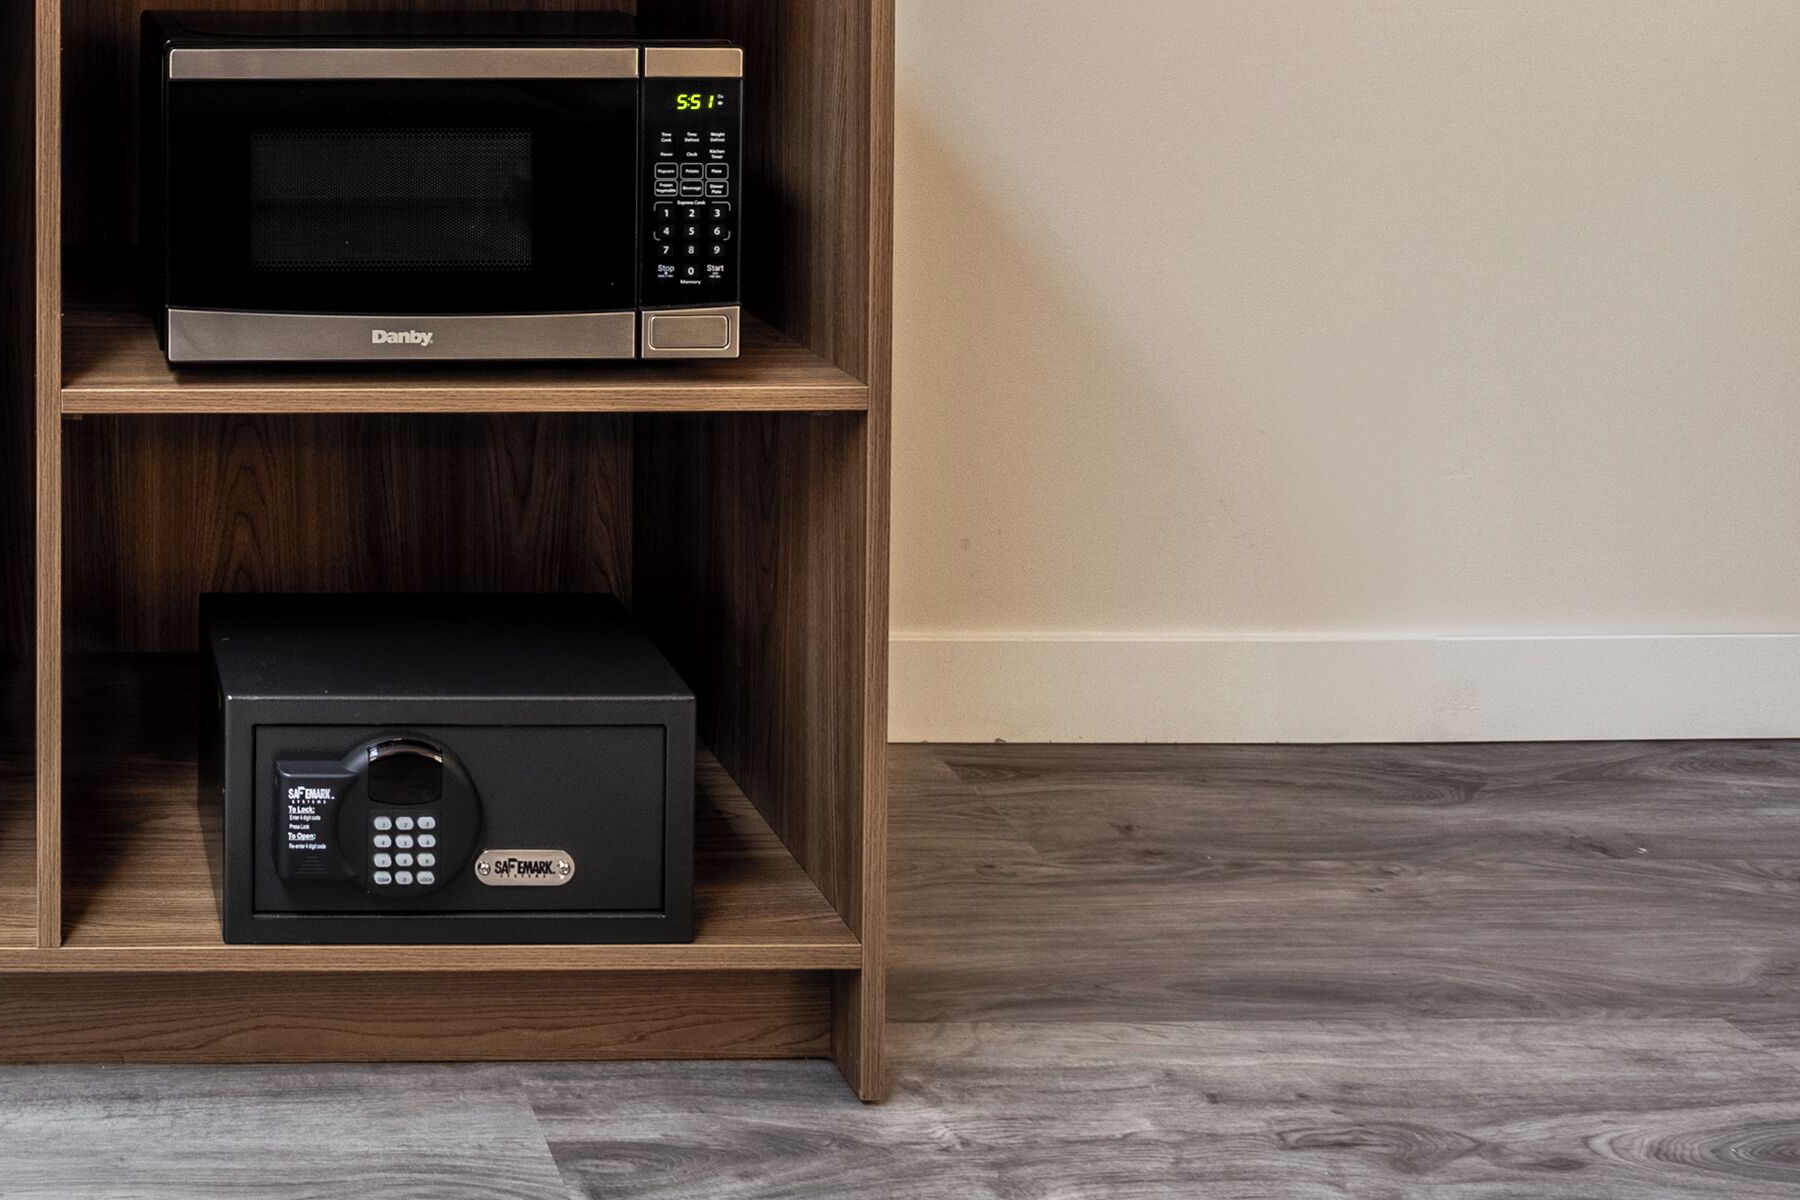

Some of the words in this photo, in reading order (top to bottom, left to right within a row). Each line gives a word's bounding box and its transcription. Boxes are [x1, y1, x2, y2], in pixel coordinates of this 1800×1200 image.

[677, 94, 714, 110] 5:51
[664, 209, 669, 218] 1
[688, 209, 695, 218] 2
[714, 209, 721, 218] 3
[663, 227, 670, 236] 4
[688, 227, 695, 236] 5
[713, 227, 721, 236] 6
[663, 246, 670, 255] 7
[688, 246, 695, 255] 8
[713, 246, 721, 255] 9
[657, 264, 675, 273] Stop
[687, 267, 695, 276] 0
[706, 264, 724, 272] Start
[371, 329, 434, 347] Danby
[288, 786, 331, 800] SAFEMARK
[288, 805, 297, 814] To
[288, 832, 297, 841] To
[494, 858, 553, 874] SAFEMARK
